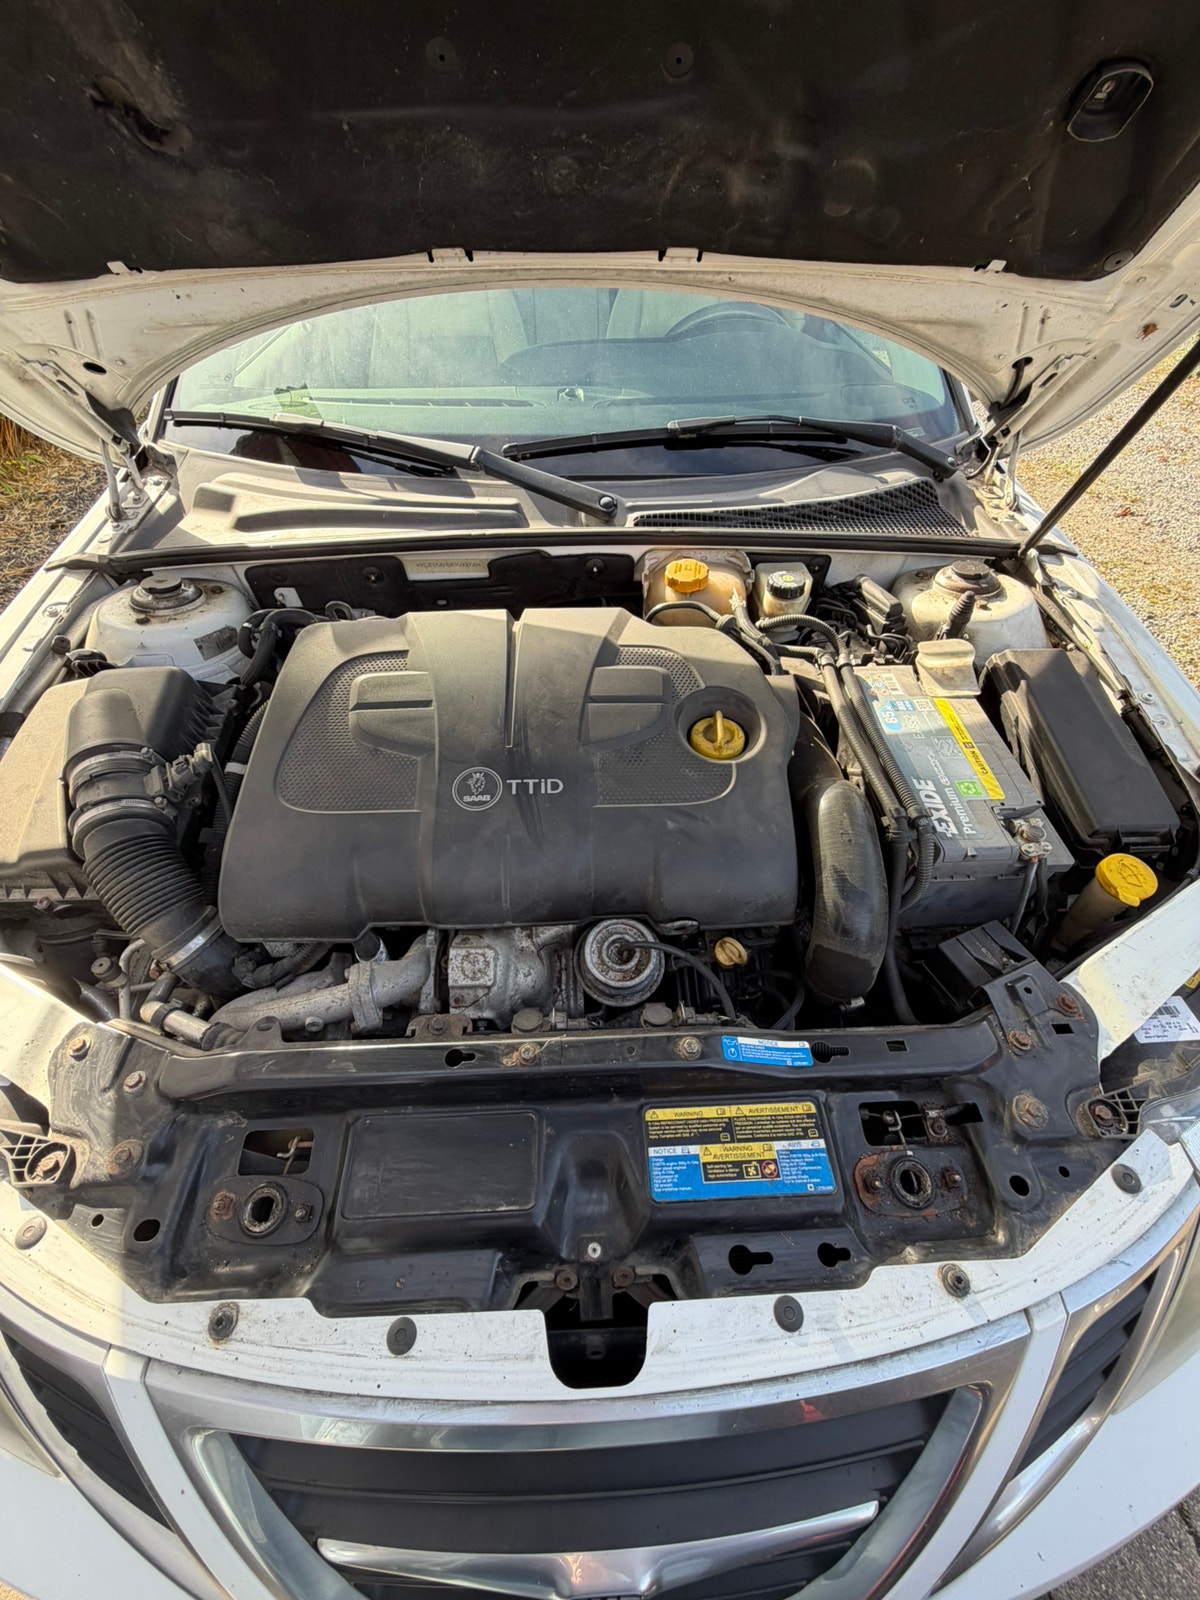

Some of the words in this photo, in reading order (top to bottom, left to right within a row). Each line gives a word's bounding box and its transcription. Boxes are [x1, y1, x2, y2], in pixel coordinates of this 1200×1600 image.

[880, 710, 899, 724] 85
[970, 750, 989, 775] CAUTION
[462, 794, 492, 802] SAAB
[911, 778, 959, 838] EXIDE
[944, 787, 977, 835] Premium
[757, 1040, 778, 1048] NOTICE
[748, 1106, 799, 1114] AVERTISSEMENT
[653, 1147, 678, 1155] NOTICE
[712, 1151, 765, 1160] AVERTISSEMENT
